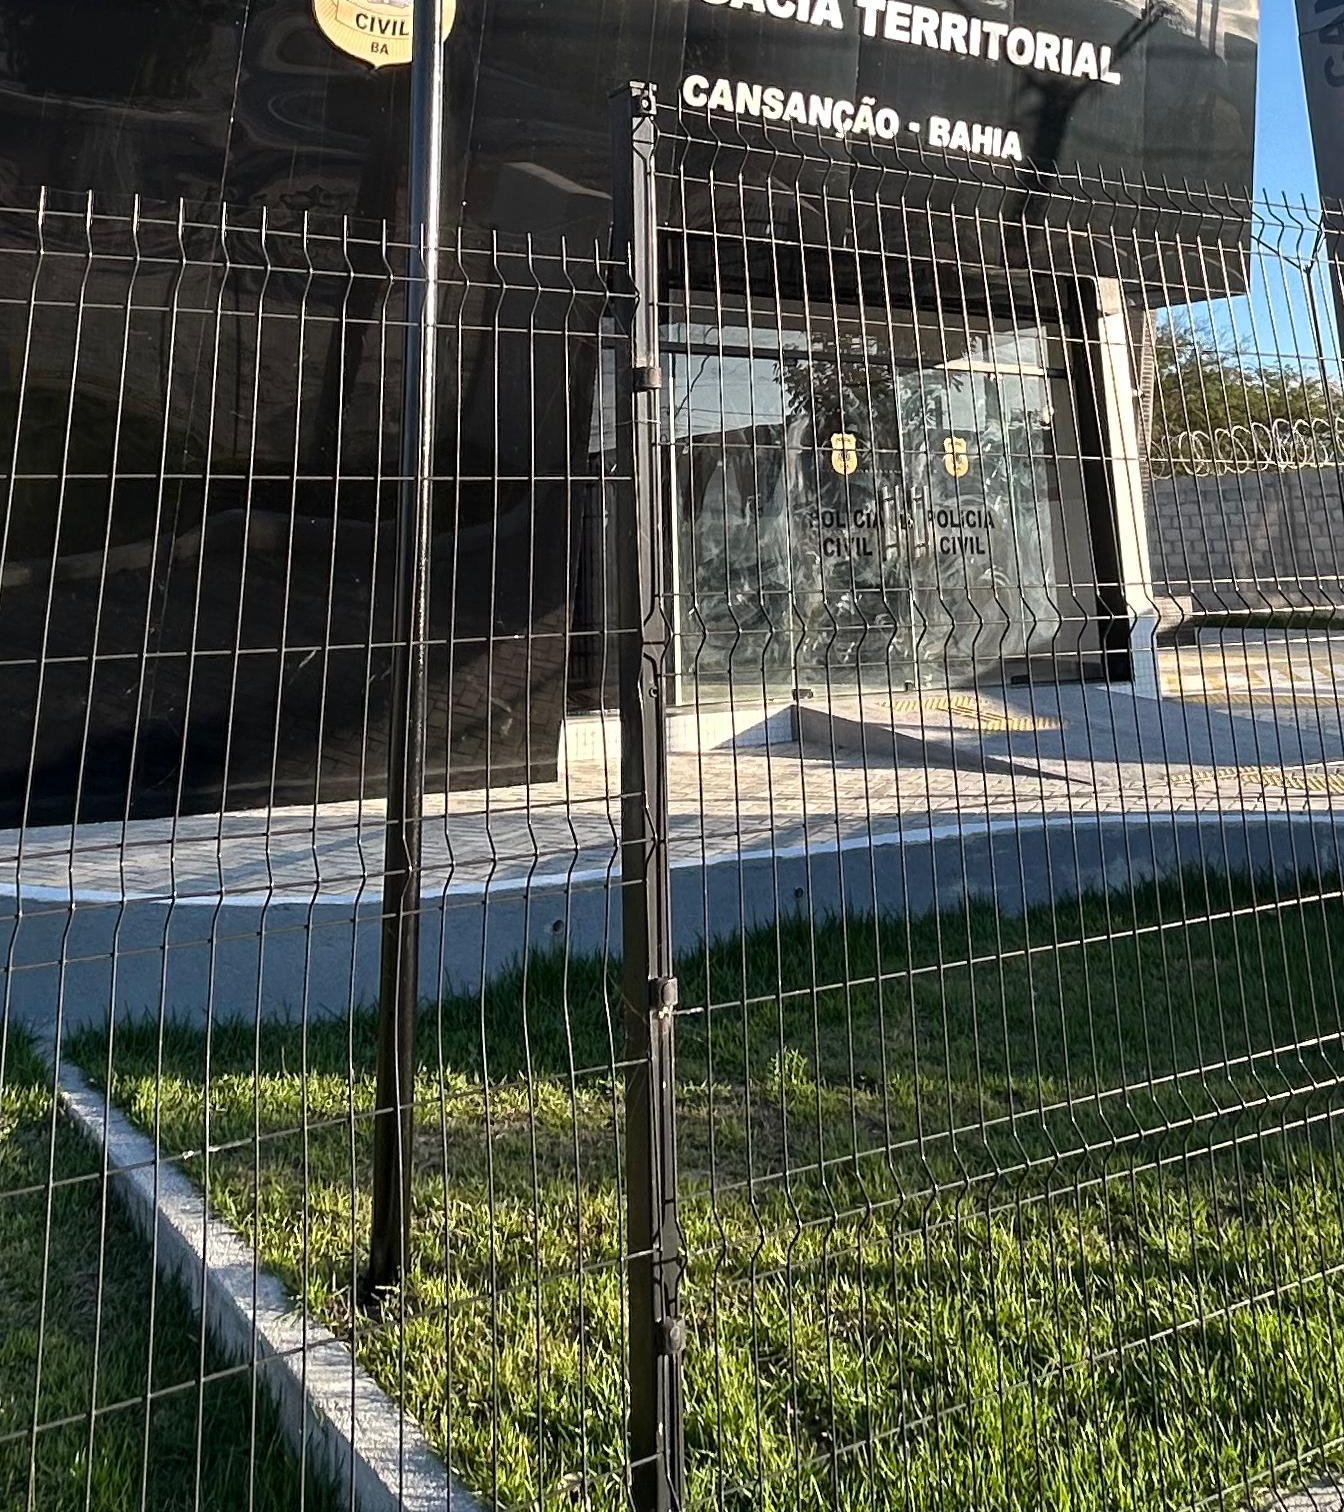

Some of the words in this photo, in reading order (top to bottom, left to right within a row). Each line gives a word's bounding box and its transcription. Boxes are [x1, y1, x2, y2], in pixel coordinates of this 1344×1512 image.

[355, 13, 410, 37] CIVIL
[370, 41, 390, 56] BA
[682, 74, 901, 142] CANSANÇÃO
[908, 121, 922, 135] -
[928, 116, 1023, 162] BAHIA
[823, 537, 873, 557] CIVIL
[940, 536, 986, 555] CIVIL
